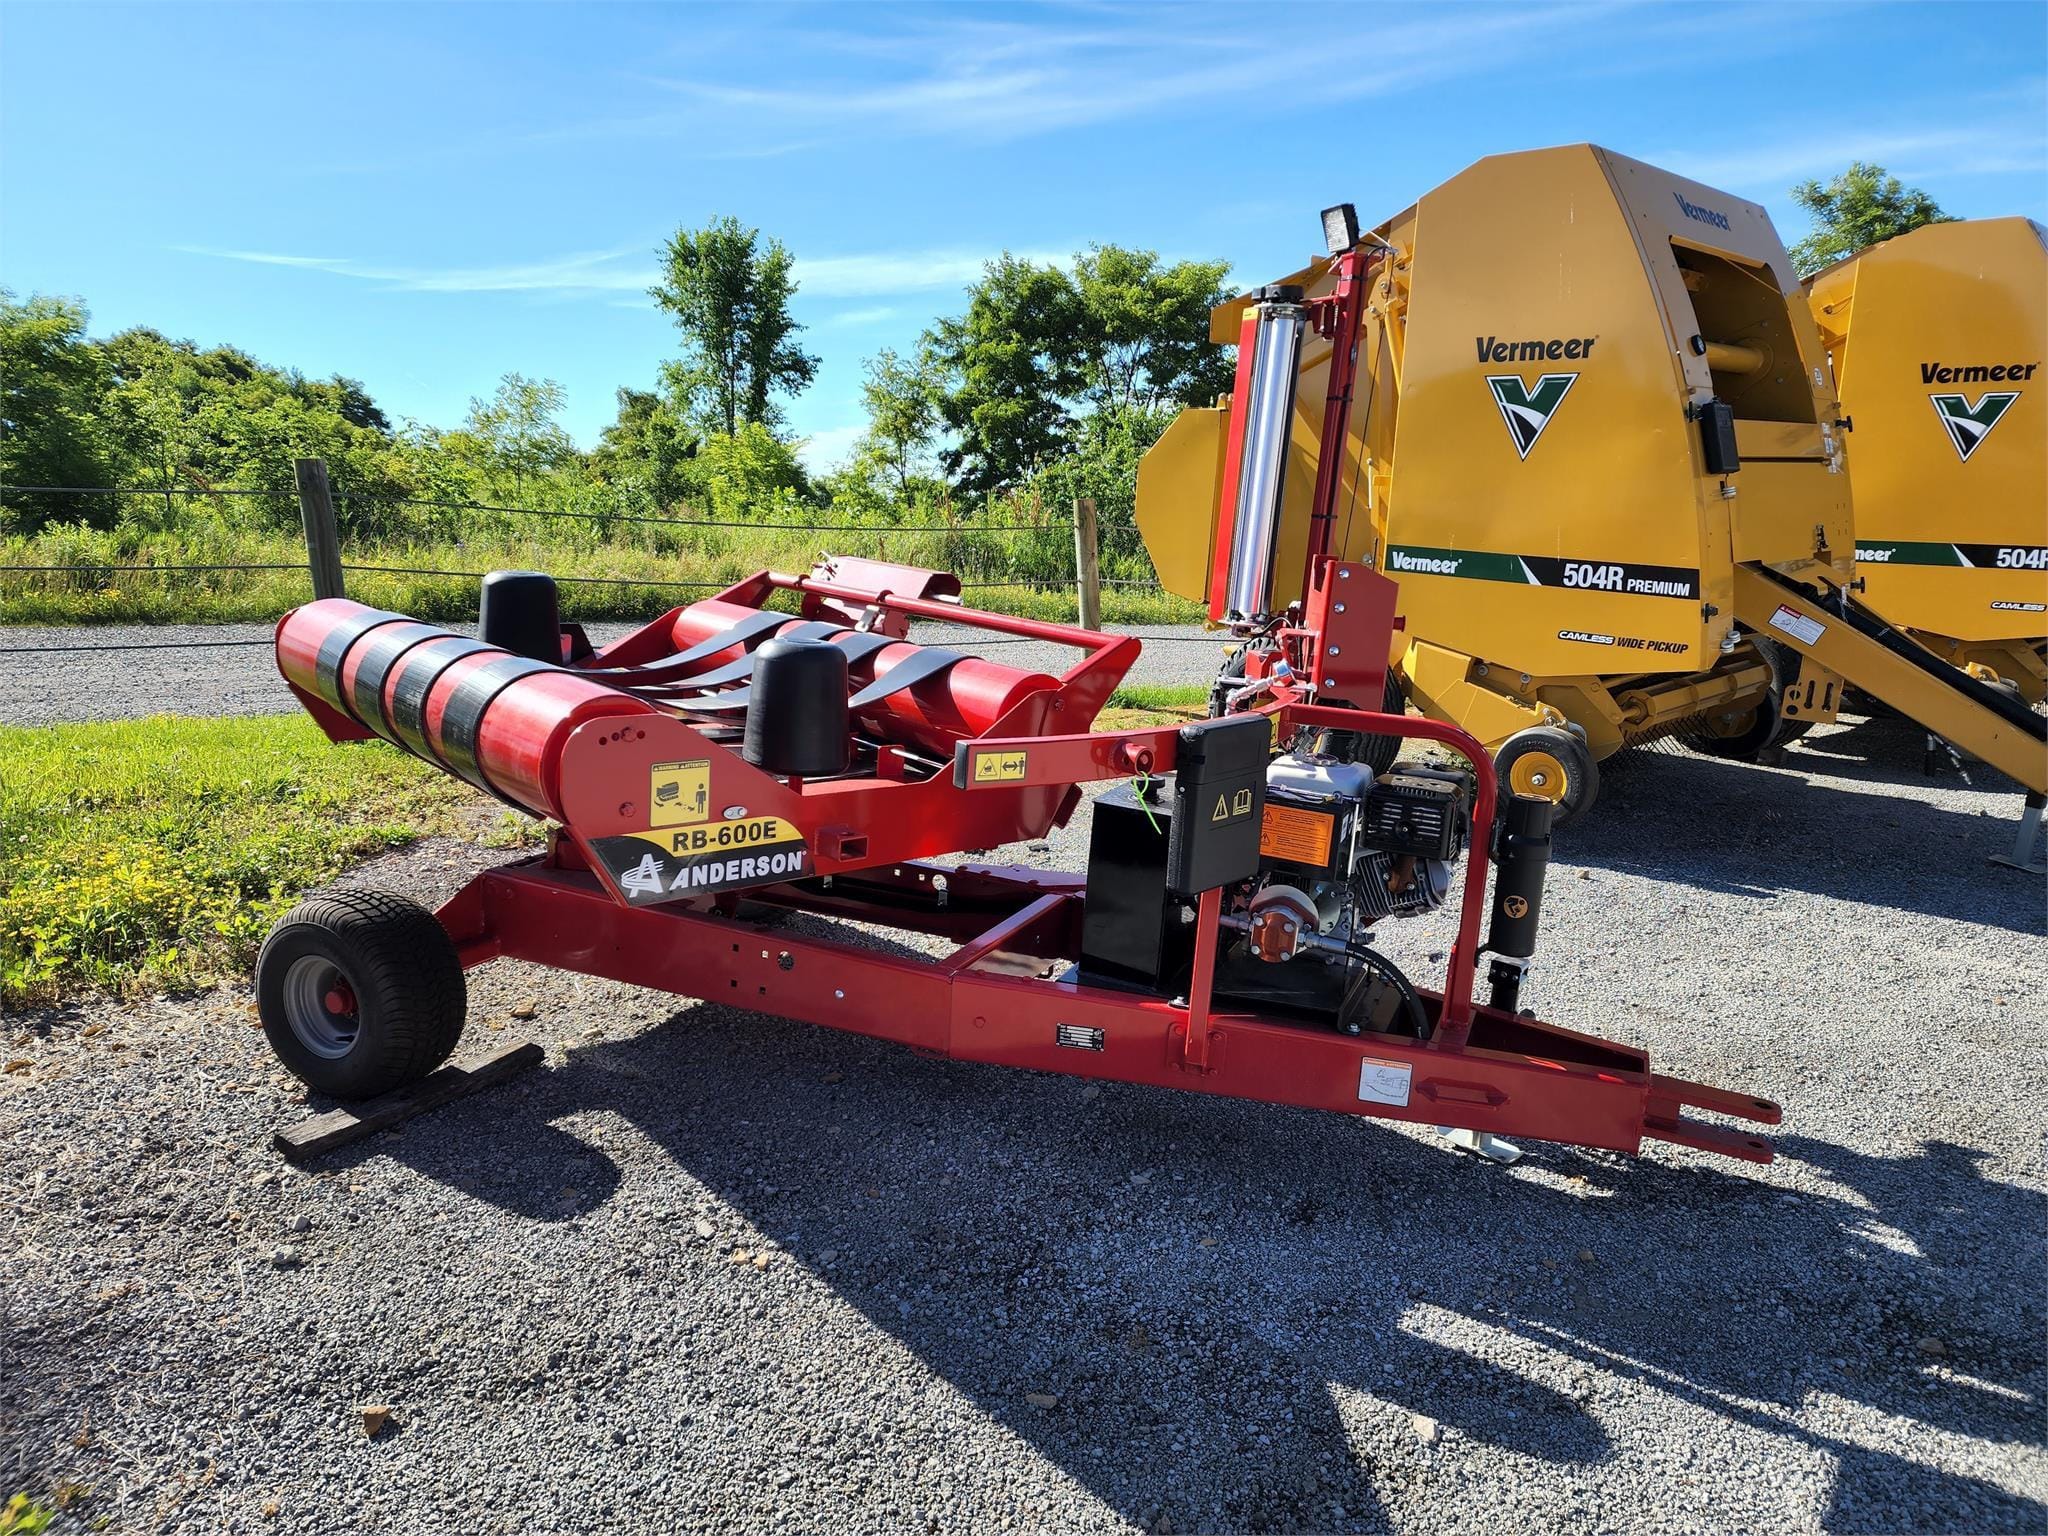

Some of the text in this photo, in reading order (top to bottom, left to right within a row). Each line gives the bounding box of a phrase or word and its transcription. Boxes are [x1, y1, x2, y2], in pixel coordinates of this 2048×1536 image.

[1673, 191, 1731, 231] Vermeer
[1476, 336, 1596, 363] Vermeer
[1920, 362, 2038, 384] Vermeer
[1392, 551, 1459, 574] Vermeer
[1563, 562, 1691, 597] 504R PREMIUM
[1991, 601, 2046, 612] CAMLESS
[1559, 631, 1689, 655] CAMLESS WIDE PICKUP
[672, 821, 777, 852] RB-600E
[669, 851, 802, 891] ANDERSON
